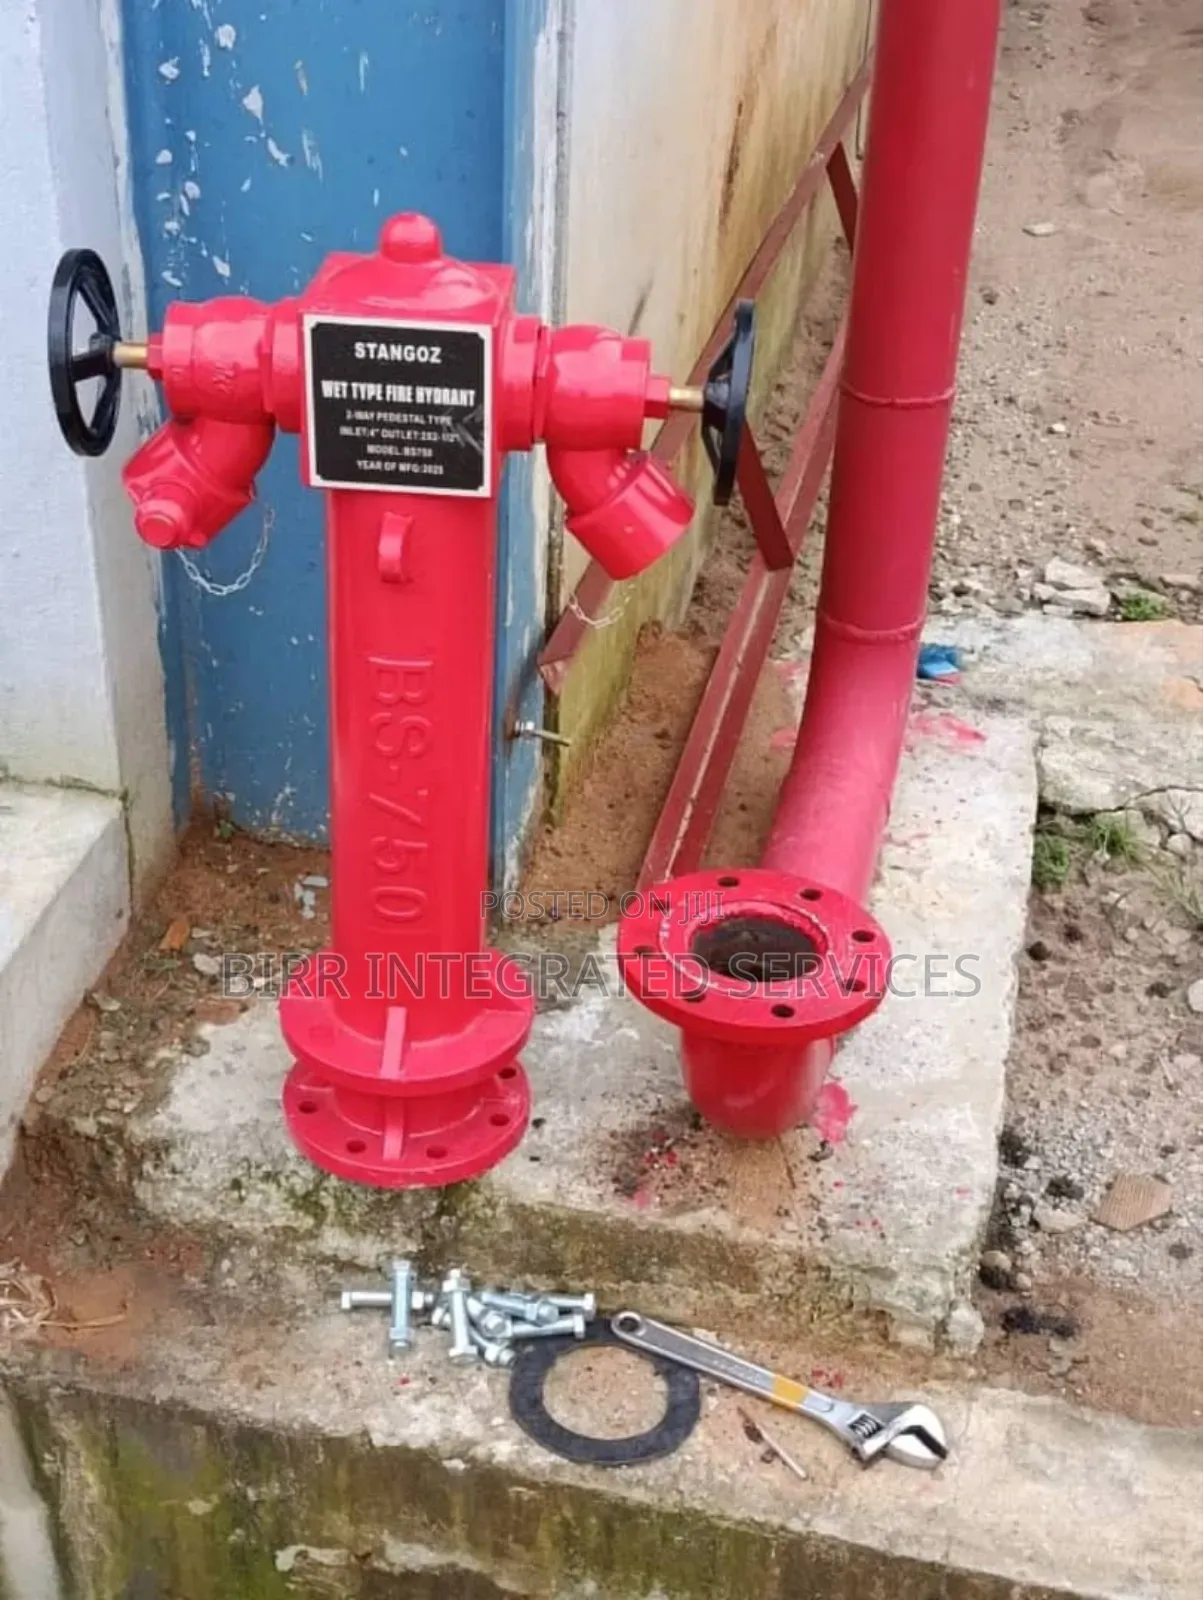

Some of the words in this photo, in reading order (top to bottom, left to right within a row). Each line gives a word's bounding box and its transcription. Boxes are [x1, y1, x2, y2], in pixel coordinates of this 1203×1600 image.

[354, 342, 442, 363] STANGOZ
[320, 380, 348, 399] WET
[352, 382, 384, 401] TYPE
[386, 384, 412, 403] FIRE
[415, 387, 476, 407] HYDRANT
[376, 411, 425, 425] PEDESTAL
[428, 414, 452, 426] TYPE
[356, 460, 382, 471] YEAR
[384, 461, 397, 471] OF
